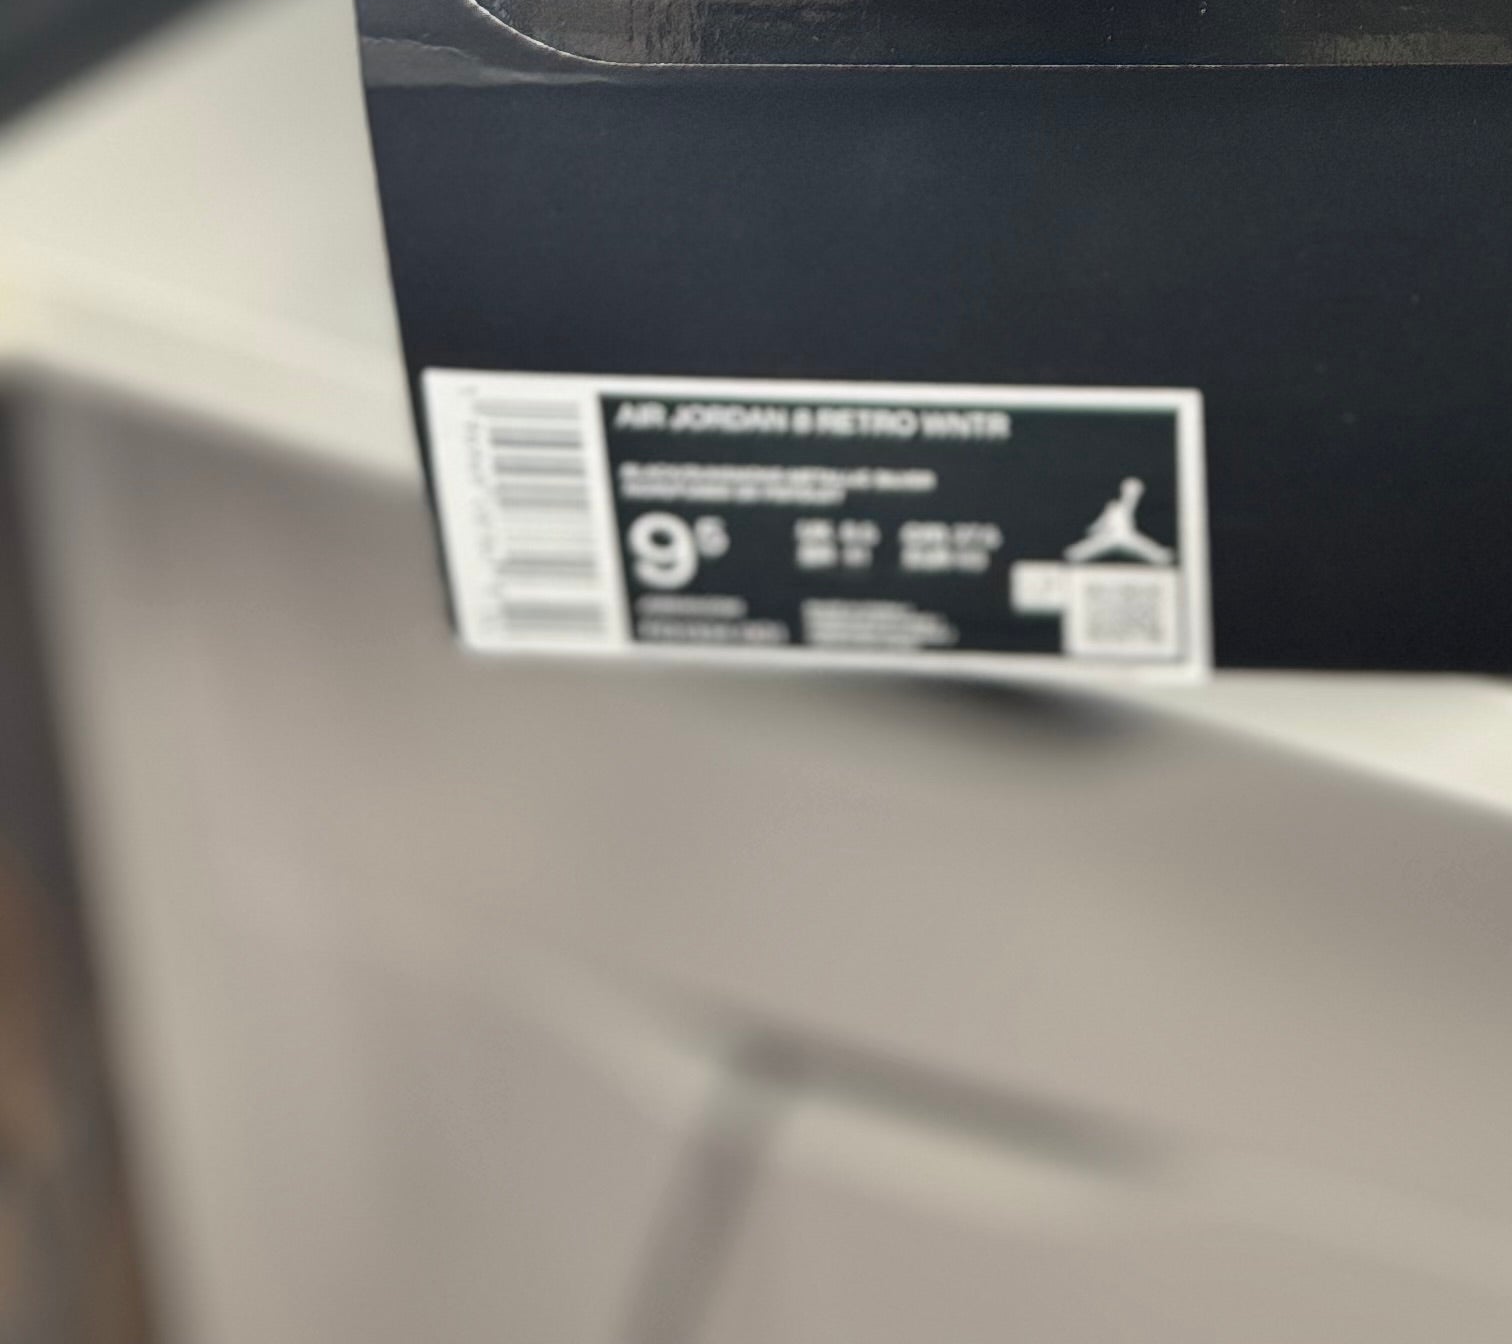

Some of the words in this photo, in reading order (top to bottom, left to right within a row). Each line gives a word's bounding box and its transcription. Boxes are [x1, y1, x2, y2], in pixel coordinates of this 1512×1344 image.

[614, 402, 667, 429] AIR
[670, 403, 789, 434] JORDAN
[815, 407, 918, 439] RETRO
